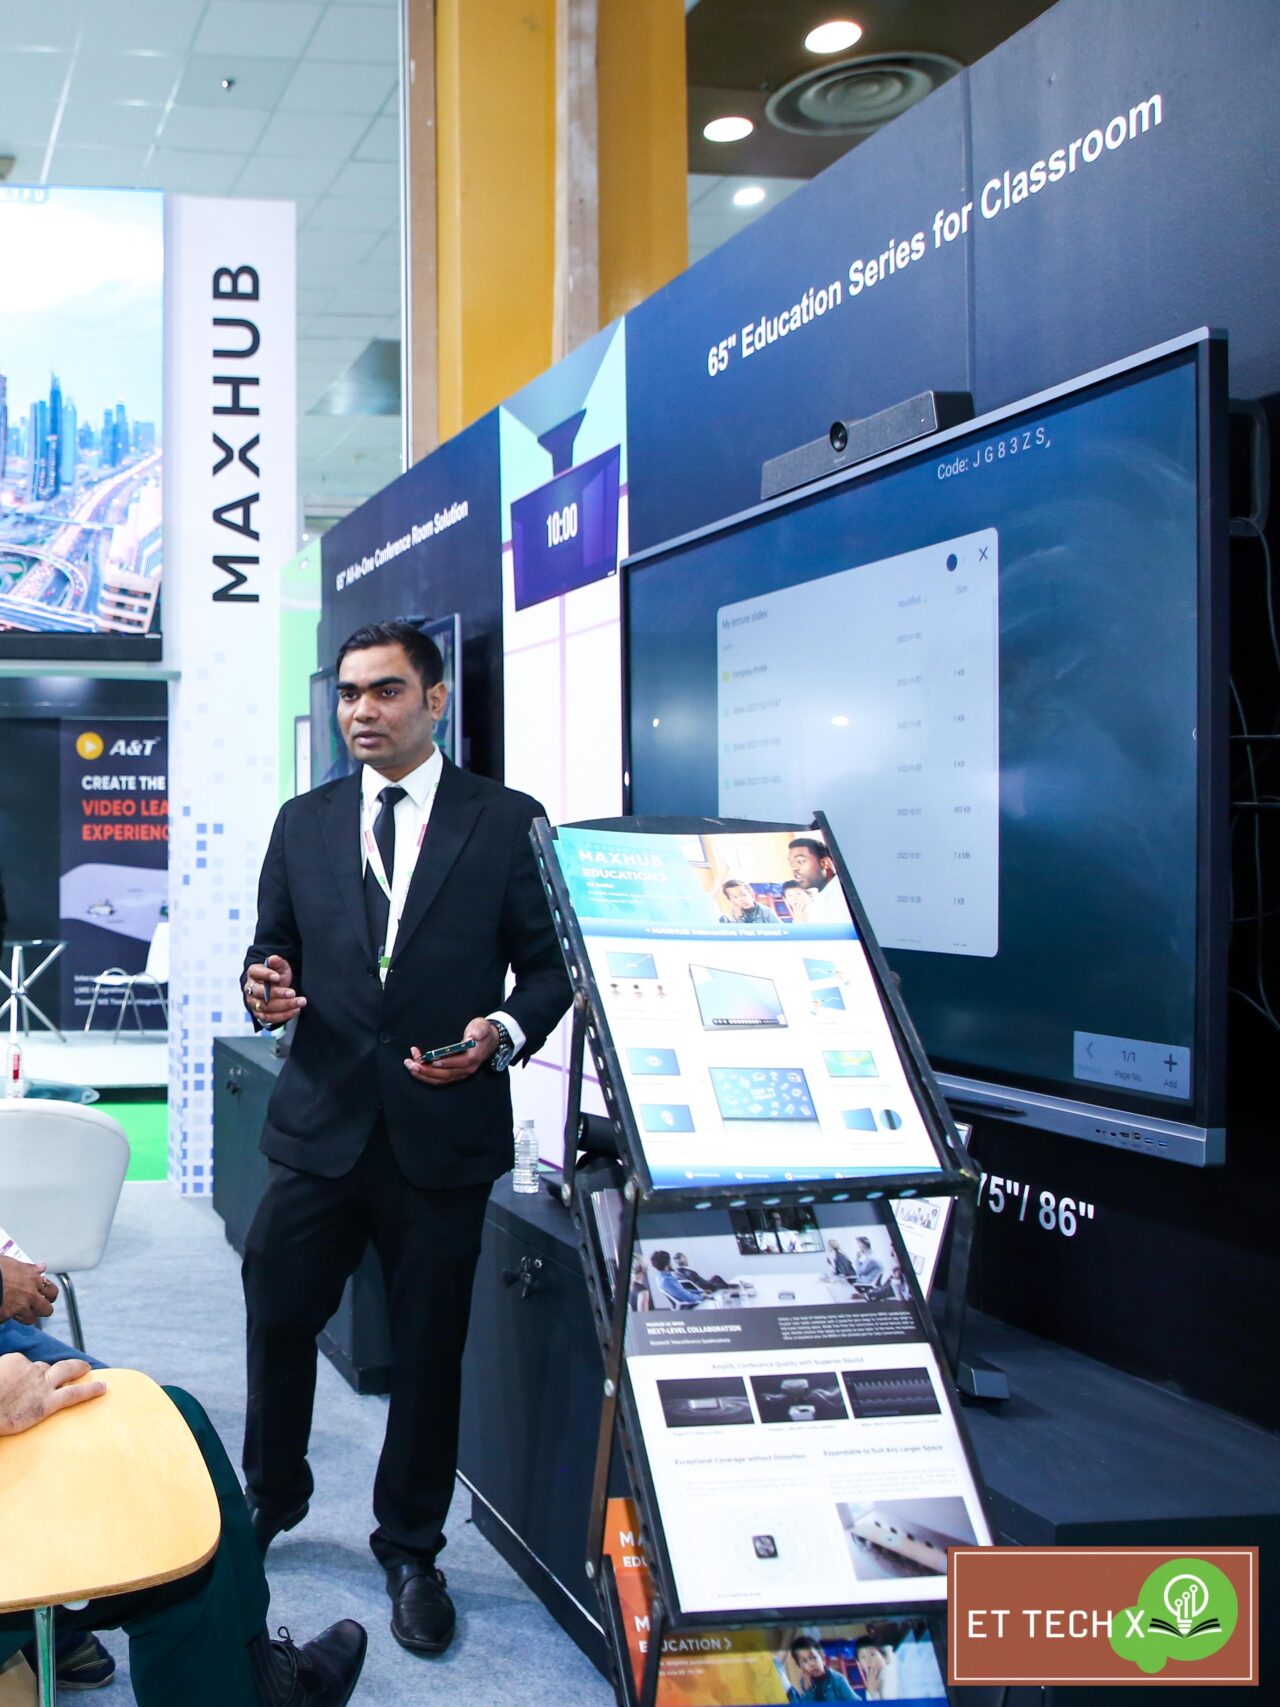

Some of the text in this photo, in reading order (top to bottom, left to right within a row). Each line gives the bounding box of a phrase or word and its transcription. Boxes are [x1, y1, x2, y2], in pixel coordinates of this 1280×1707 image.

[708, 94, 1162, 376] 65" Education Series for Classroom
[213, 265, 260, 602] MAXHUB
[937, 457, 969, 480] Code:
[374, 533, 411, 568] Conference
[411, 519, 433, 546] Room
[433, 500, 468, 534] Solution
[547, 503, 578, 547] 10:00
[109, 739, 156, 756] A&T
[81, 775, 166, 790] CREATE THE
[82, 799, 168, 816] VIDEO LEA
[82, 823, 170, 841] EXPERIENC
[578, 850, 663, 867] MAXHUB
[582, 868, 658, 881] EDUCATION
[1039, 1190, 1094, 1237] 86"
